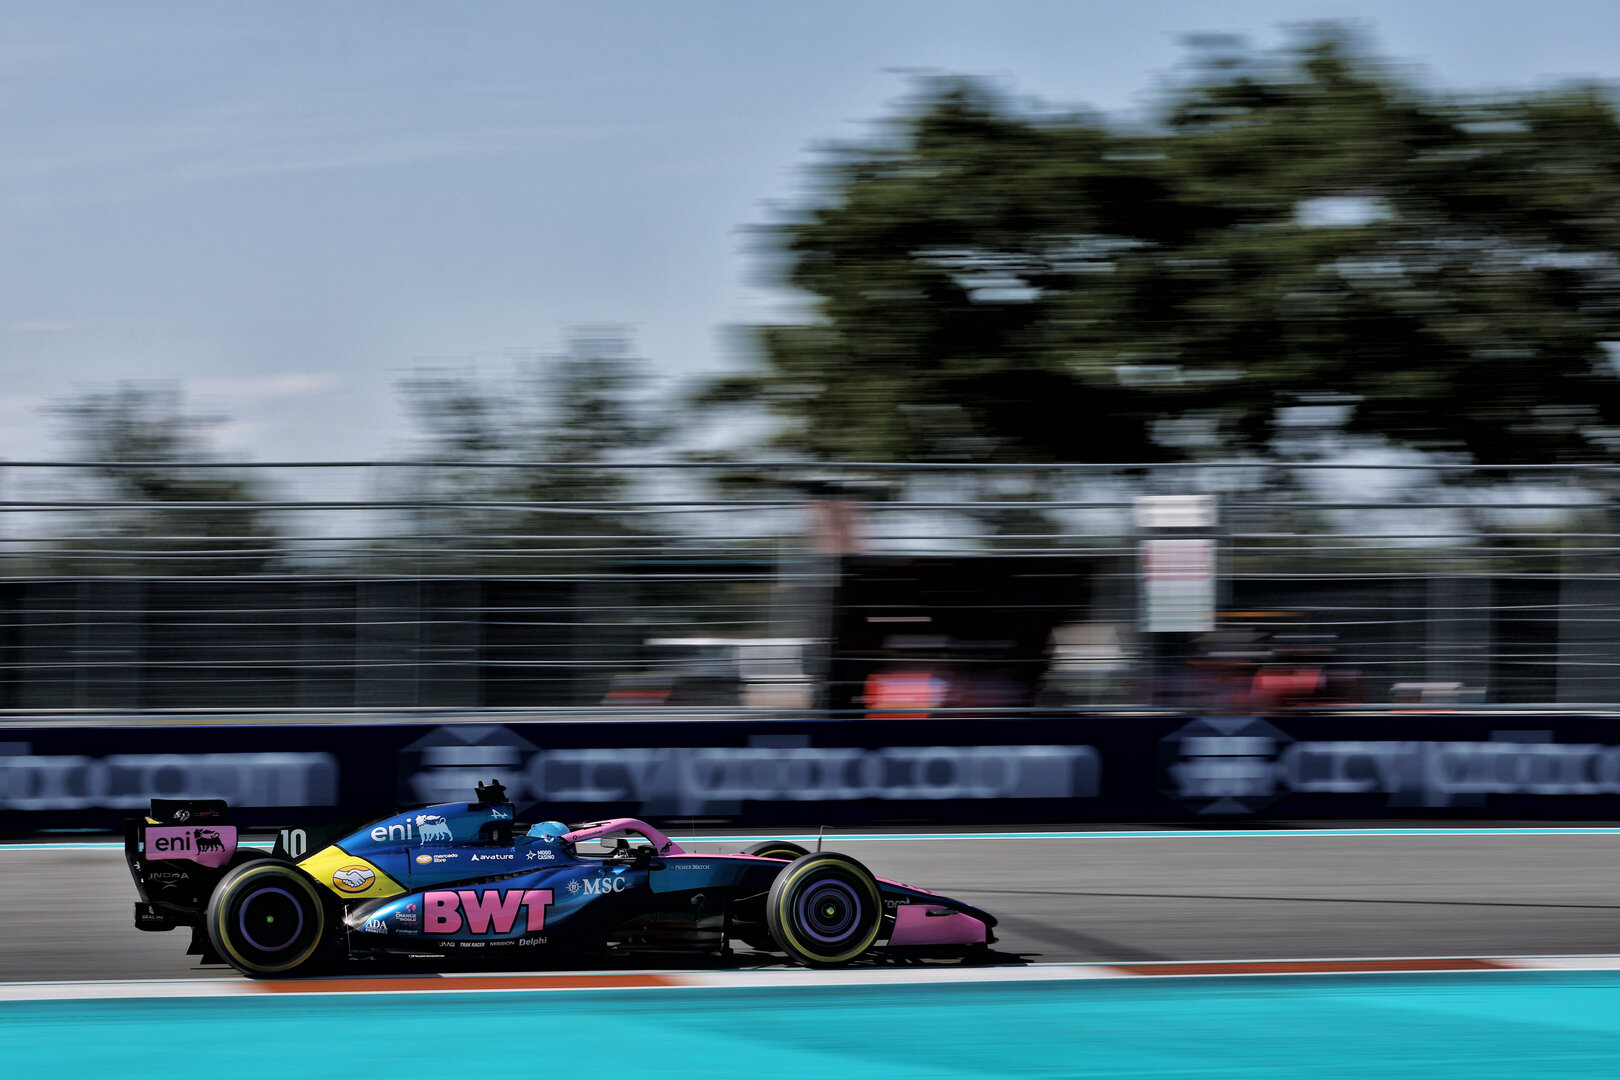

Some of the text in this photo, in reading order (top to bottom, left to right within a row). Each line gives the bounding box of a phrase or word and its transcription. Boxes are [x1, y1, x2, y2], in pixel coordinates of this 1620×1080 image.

[371, 818, 412, 842] eni
[155, 831, 191, 851] eni
[281, 829, 307, 859] 10
[582, 876, 625, 896] MSC
[423, 889, 554, 934] BWT
[365, 919, 387, 929] ADA
[519, 936, 547, 946] Delphi
